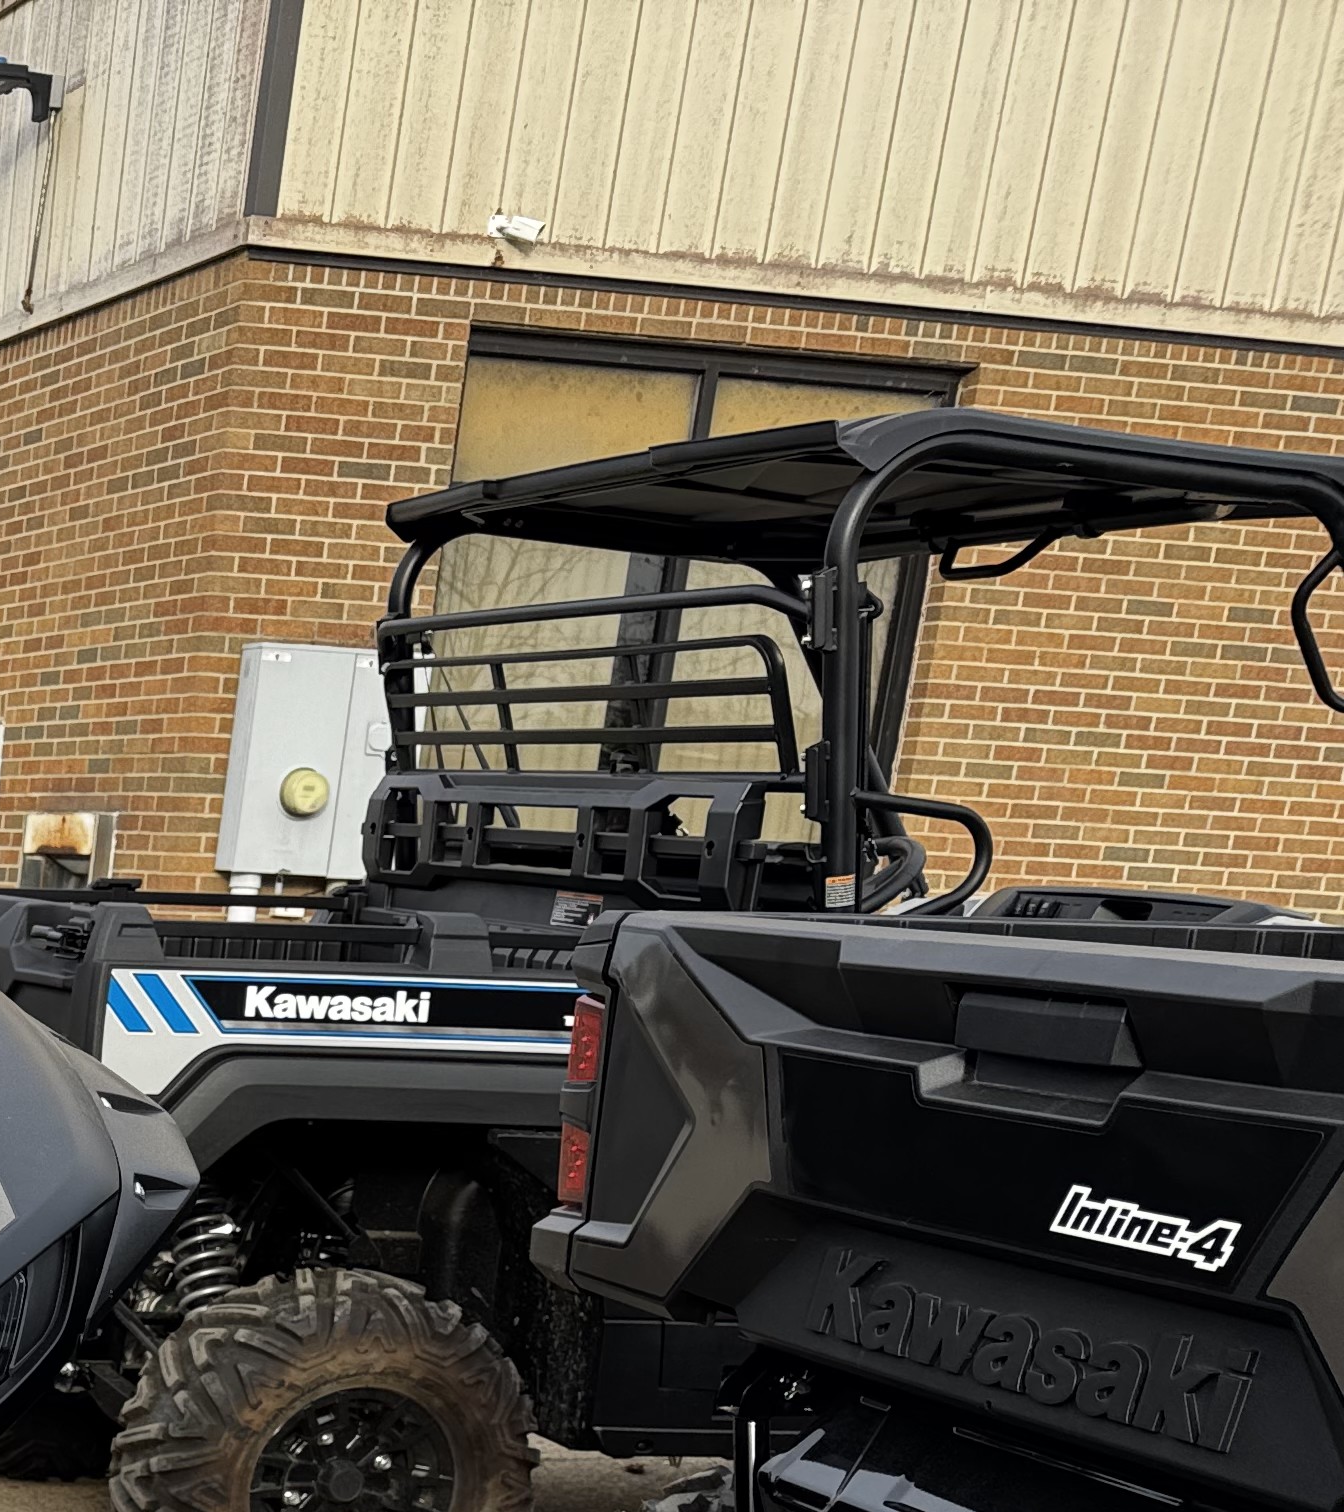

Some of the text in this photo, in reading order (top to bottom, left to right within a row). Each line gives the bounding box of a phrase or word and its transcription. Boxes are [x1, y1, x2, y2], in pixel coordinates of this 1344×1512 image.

[244, 985, 431, 1023] Kawasaki
[1049, 1184, 1242, 1271] Inline-4
[809, 1248, 1260, 1454] Kawasaki
